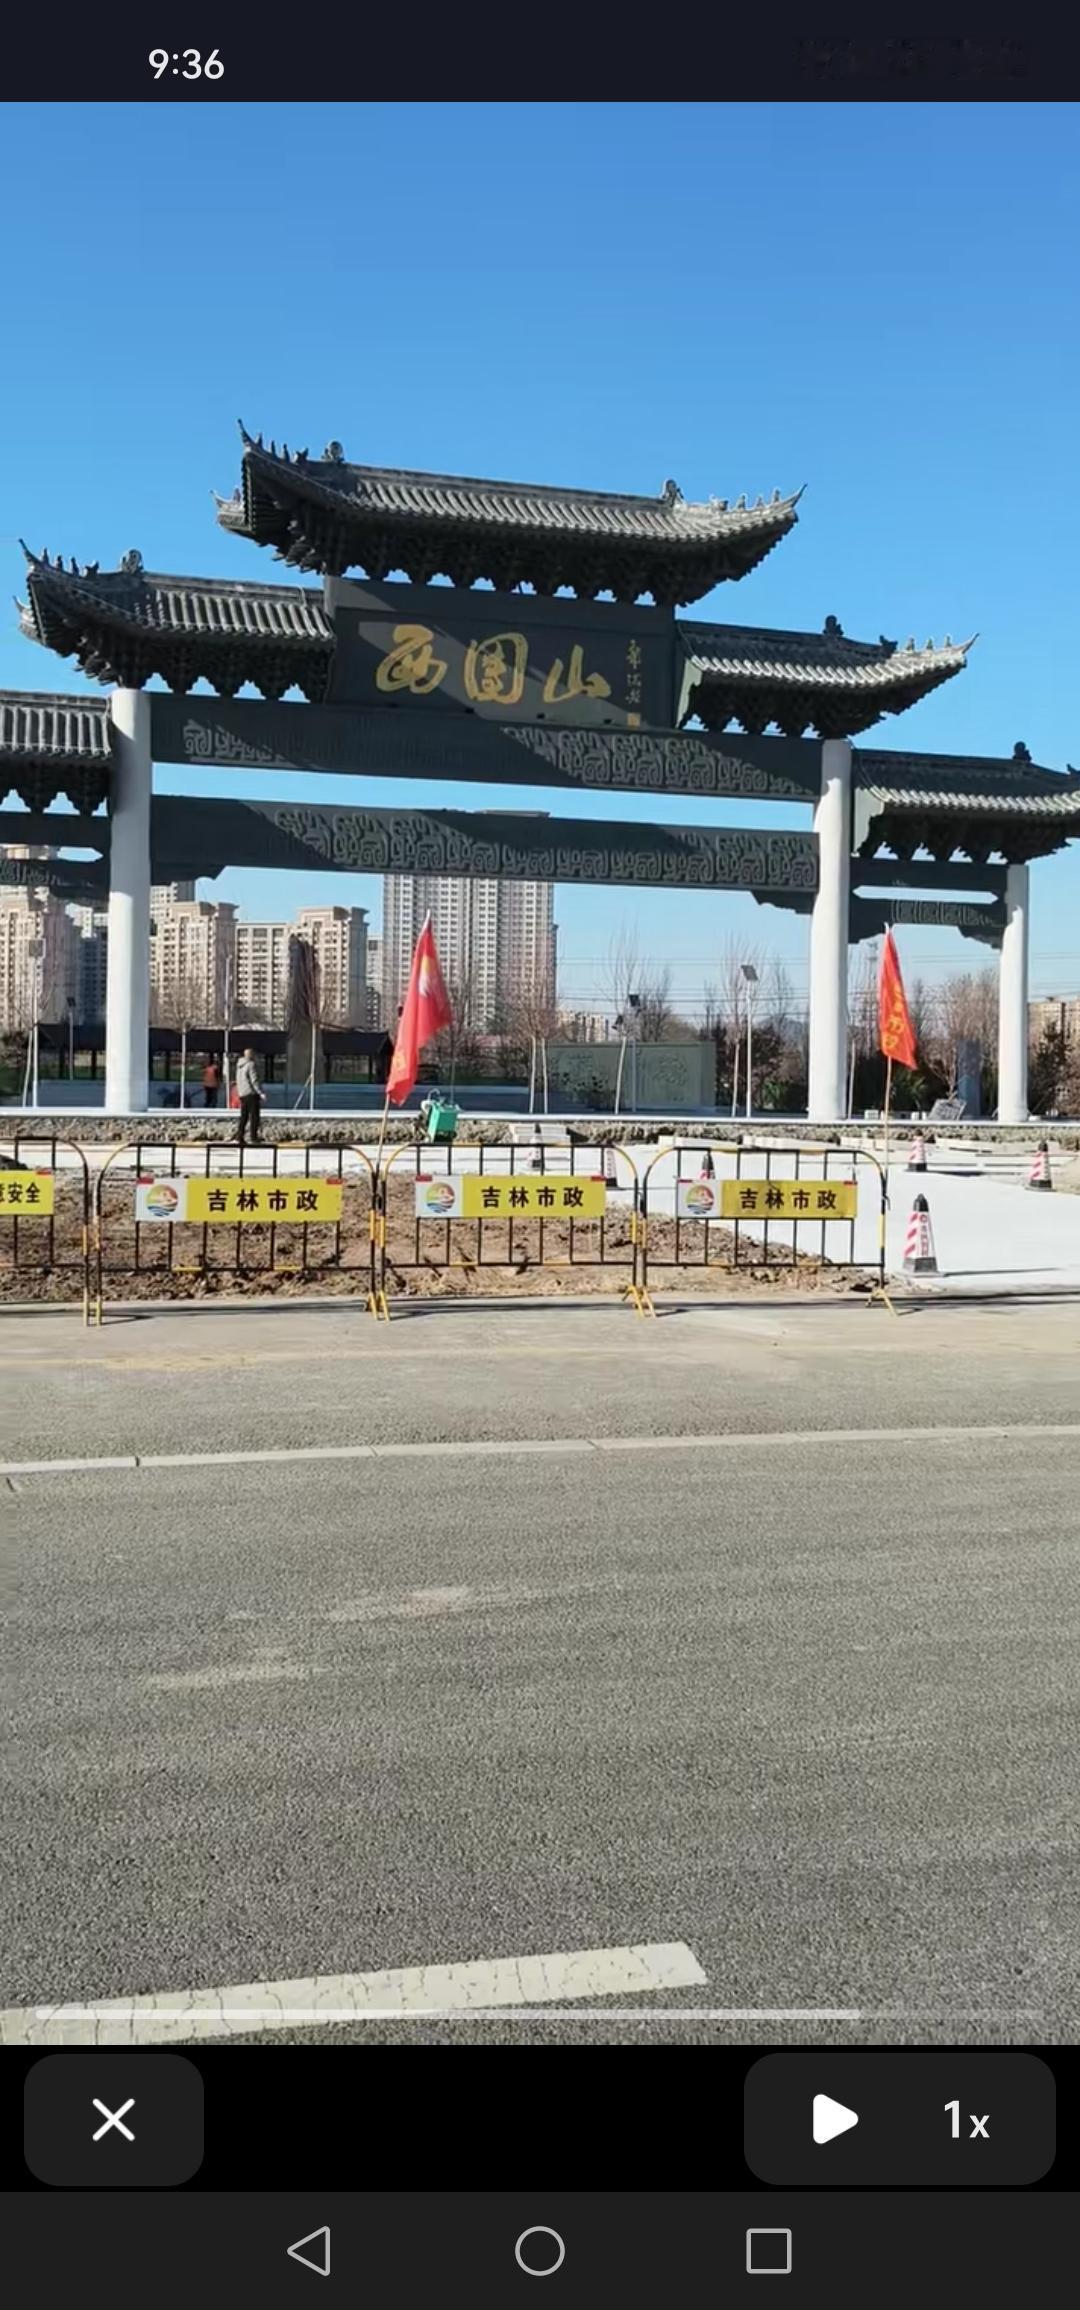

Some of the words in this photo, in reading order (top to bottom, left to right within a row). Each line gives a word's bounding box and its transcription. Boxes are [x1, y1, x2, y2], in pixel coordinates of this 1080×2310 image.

[149, 48, 224, 79] 9:36
[207, 1189, 319, 1212] 吉林市政
[481, 1186, 584, 1208] 吉林市政
[739, 1188, 837, 1210] 吉林市政
[944, 2100, 990, 2138] 1x
